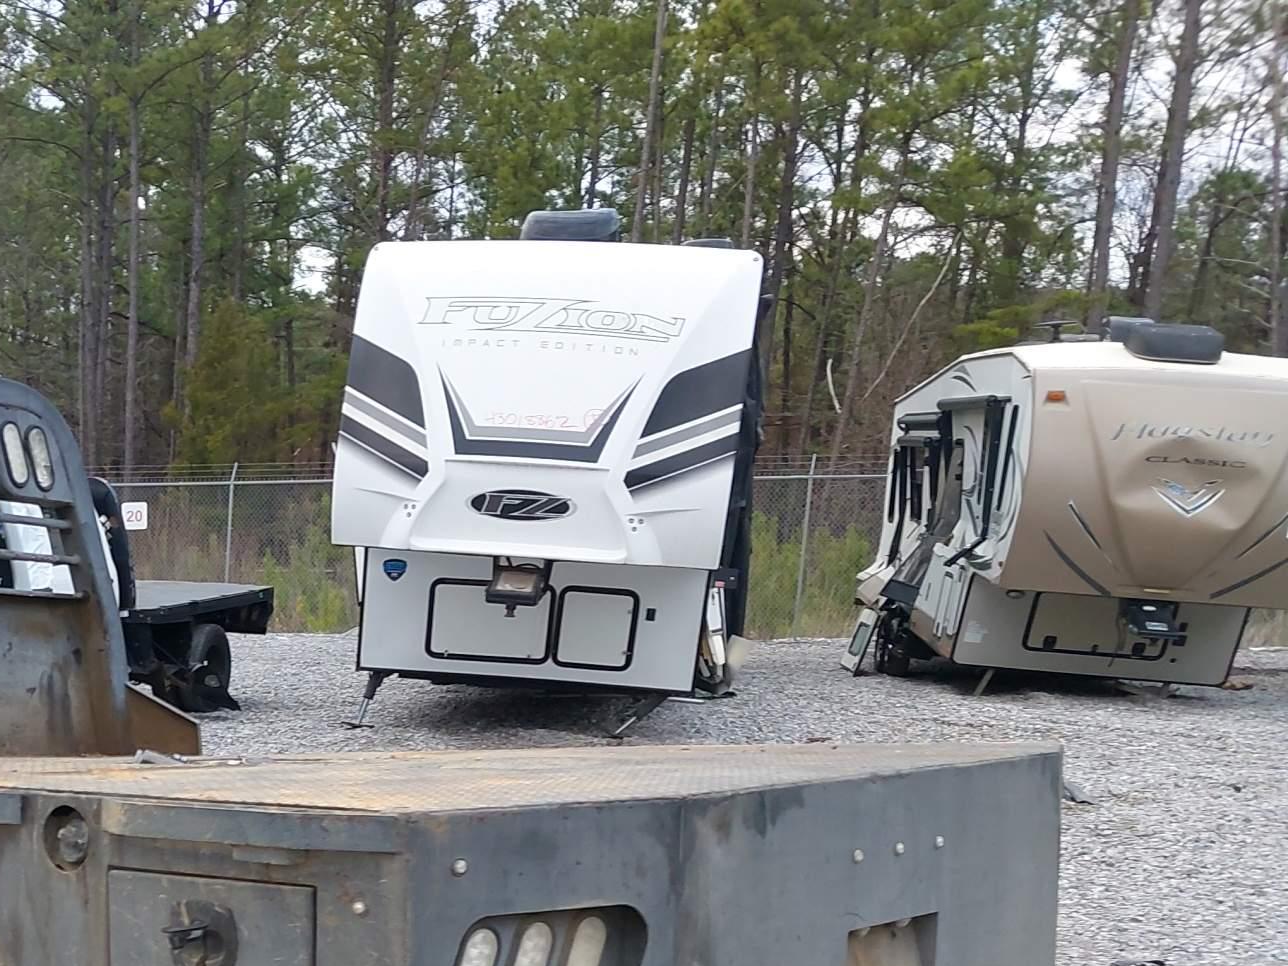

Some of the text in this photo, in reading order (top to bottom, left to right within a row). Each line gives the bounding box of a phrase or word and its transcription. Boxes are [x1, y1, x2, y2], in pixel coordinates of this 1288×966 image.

[417, 297, 686, 342] FUZION
[442, 339, 639, 356] IMPACT EDITION
[1145, 456, 1247, 468] CLASSIC
[480, 493, 572, 516] FZ
[126, 510, 142, 522] 20
